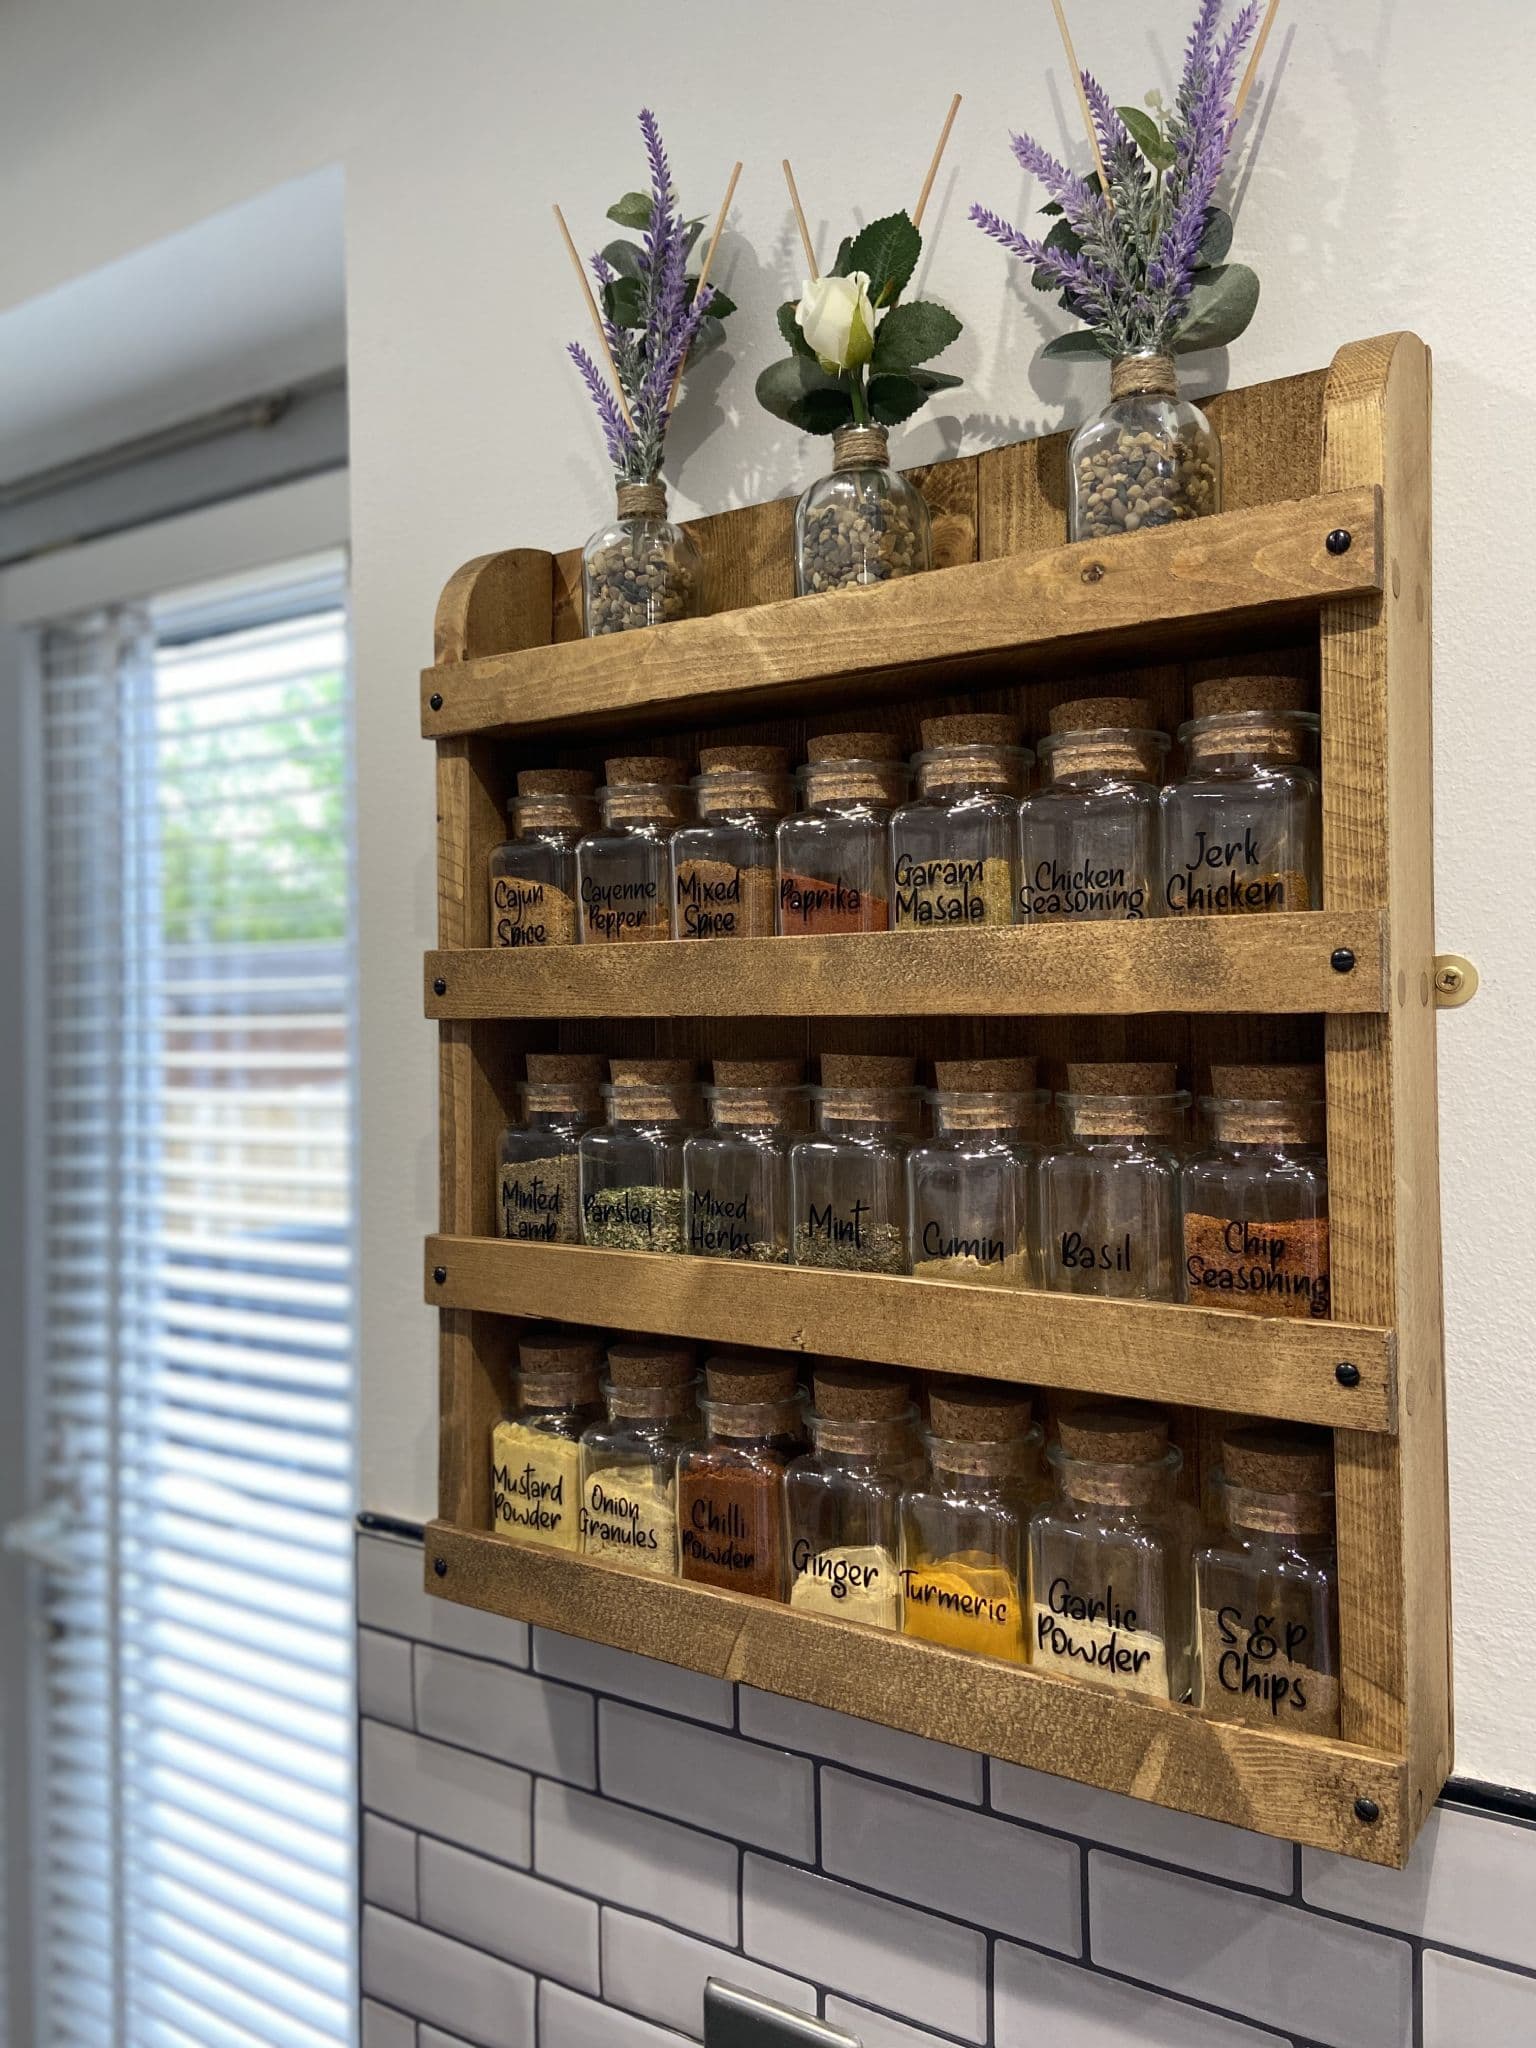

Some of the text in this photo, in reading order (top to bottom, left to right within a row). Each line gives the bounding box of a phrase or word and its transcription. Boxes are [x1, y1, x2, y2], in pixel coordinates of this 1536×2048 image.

[894, 853, 983, 887] Garam
[1186, 828, 1260, 871] Jerk
[581, 876, 657, 908] Cayenne
[677, 869, 741, 904] Mixed
[1035, 859, 1125, 892] Chicken
[1166, 870, 1285, 912] Chicken
[494, 880, 544, 925] Cajun
[780, 877, 861, 921] Paprika
[895, 882, 986, 923] Masala
[1019, 885, 1145, 920] Seasoning
[589, 905, 648, 937] Pepper
[684, 904, 736, 936] Spice
[502, 1176, 560, 1214] Minted
[583, 1191, 653, 1236] Parsley
[693, 1189, 748, 1222] Mixed
[505, 1208, 558, 1240] Lamb
[691, 1219, 751, 1252] Herbs
[808, 1200, 870, 1249] Mint
[922, 1221, 1005, 1262] Cumin
[1061, 1232, 1131, 1272] Basil
[1224, 1221, 1286, 1272] Chip
[1186, 1255, 1330, 1317] Seasoning
[491, 1463, 563, 1505] Mustard
[591, 1484, 640, 1520] Onion
[494, 1490, 562, 1531] Powder
[579, 1507, 658, 1549] Granules
[691, 1498, 746, 1539] Chilli
[682, 1529, 755, 1571] Powder
[791, 1538, 879, 1598] Ginger
[899, 1569, 1008, 1622] Turmeric
[1048, 1577, 1137, 1632] Garlic
[1037, 1612, 1151, 1673] Powder
[1218, 1650, 1307, 1716] Chips
